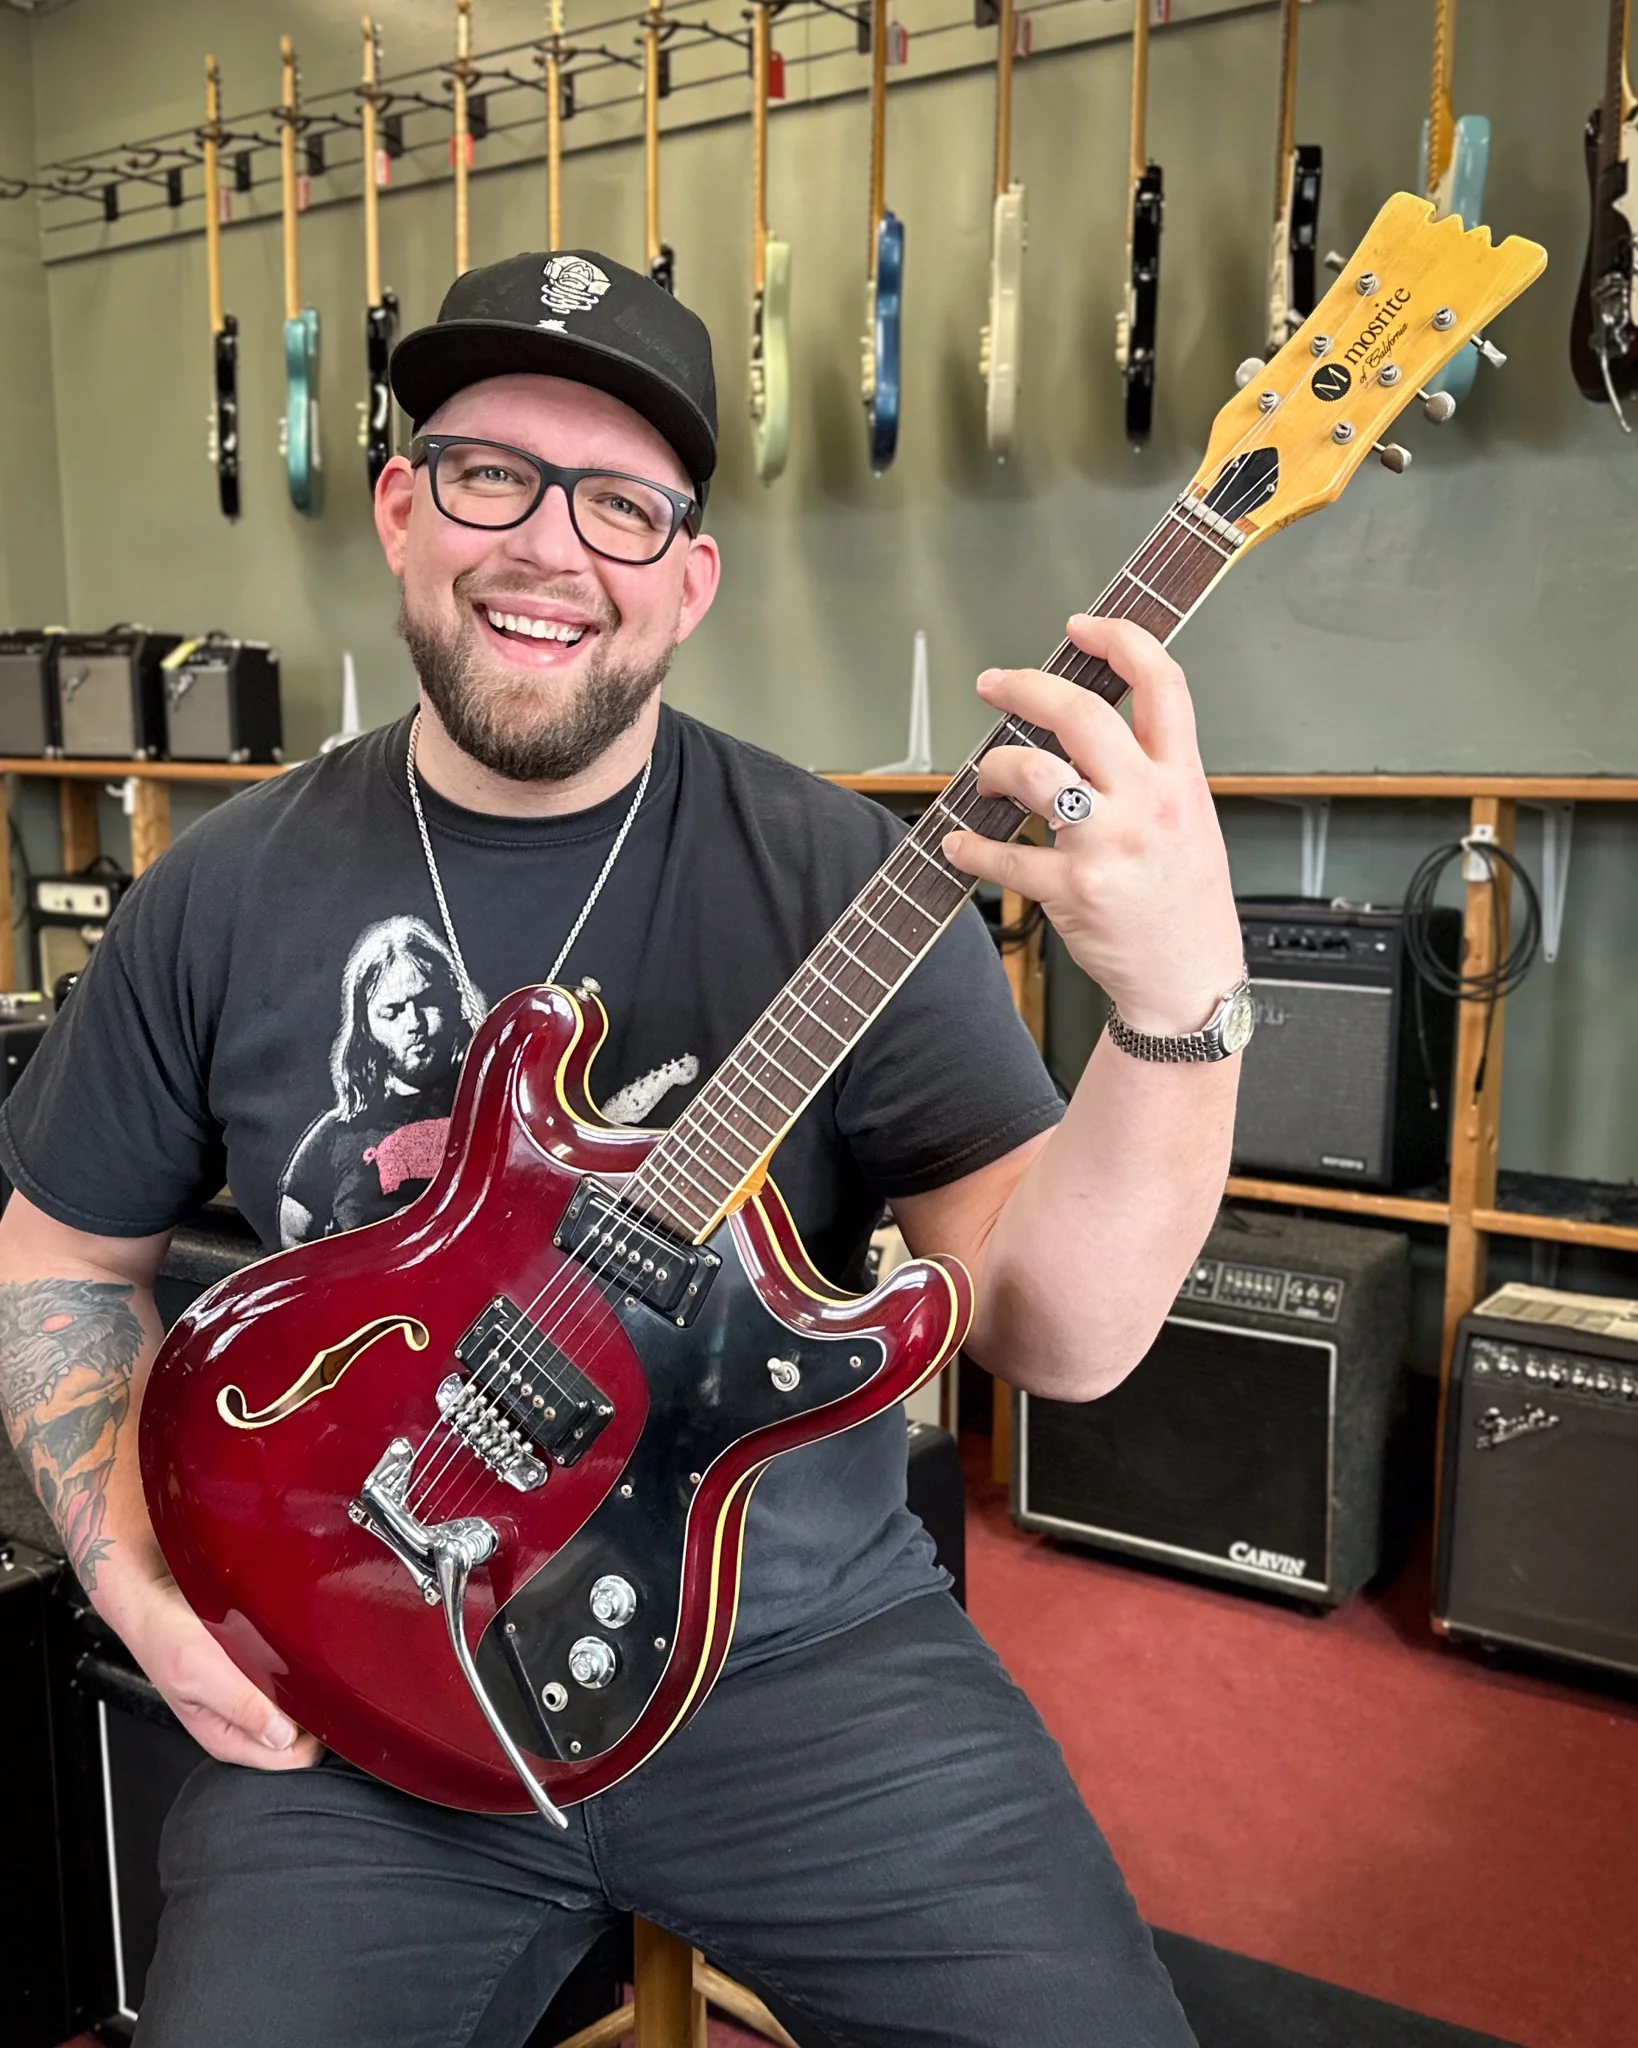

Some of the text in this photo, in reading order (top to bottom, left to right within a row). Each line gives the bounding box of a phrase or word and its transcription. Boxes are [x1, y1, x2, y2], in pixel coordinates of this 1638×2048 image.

[1313, 287, 1411, 400] M mosrite
[1364, 322, 1409, 369] California
[1228, 1540, 1306, 1578] CARVIN
